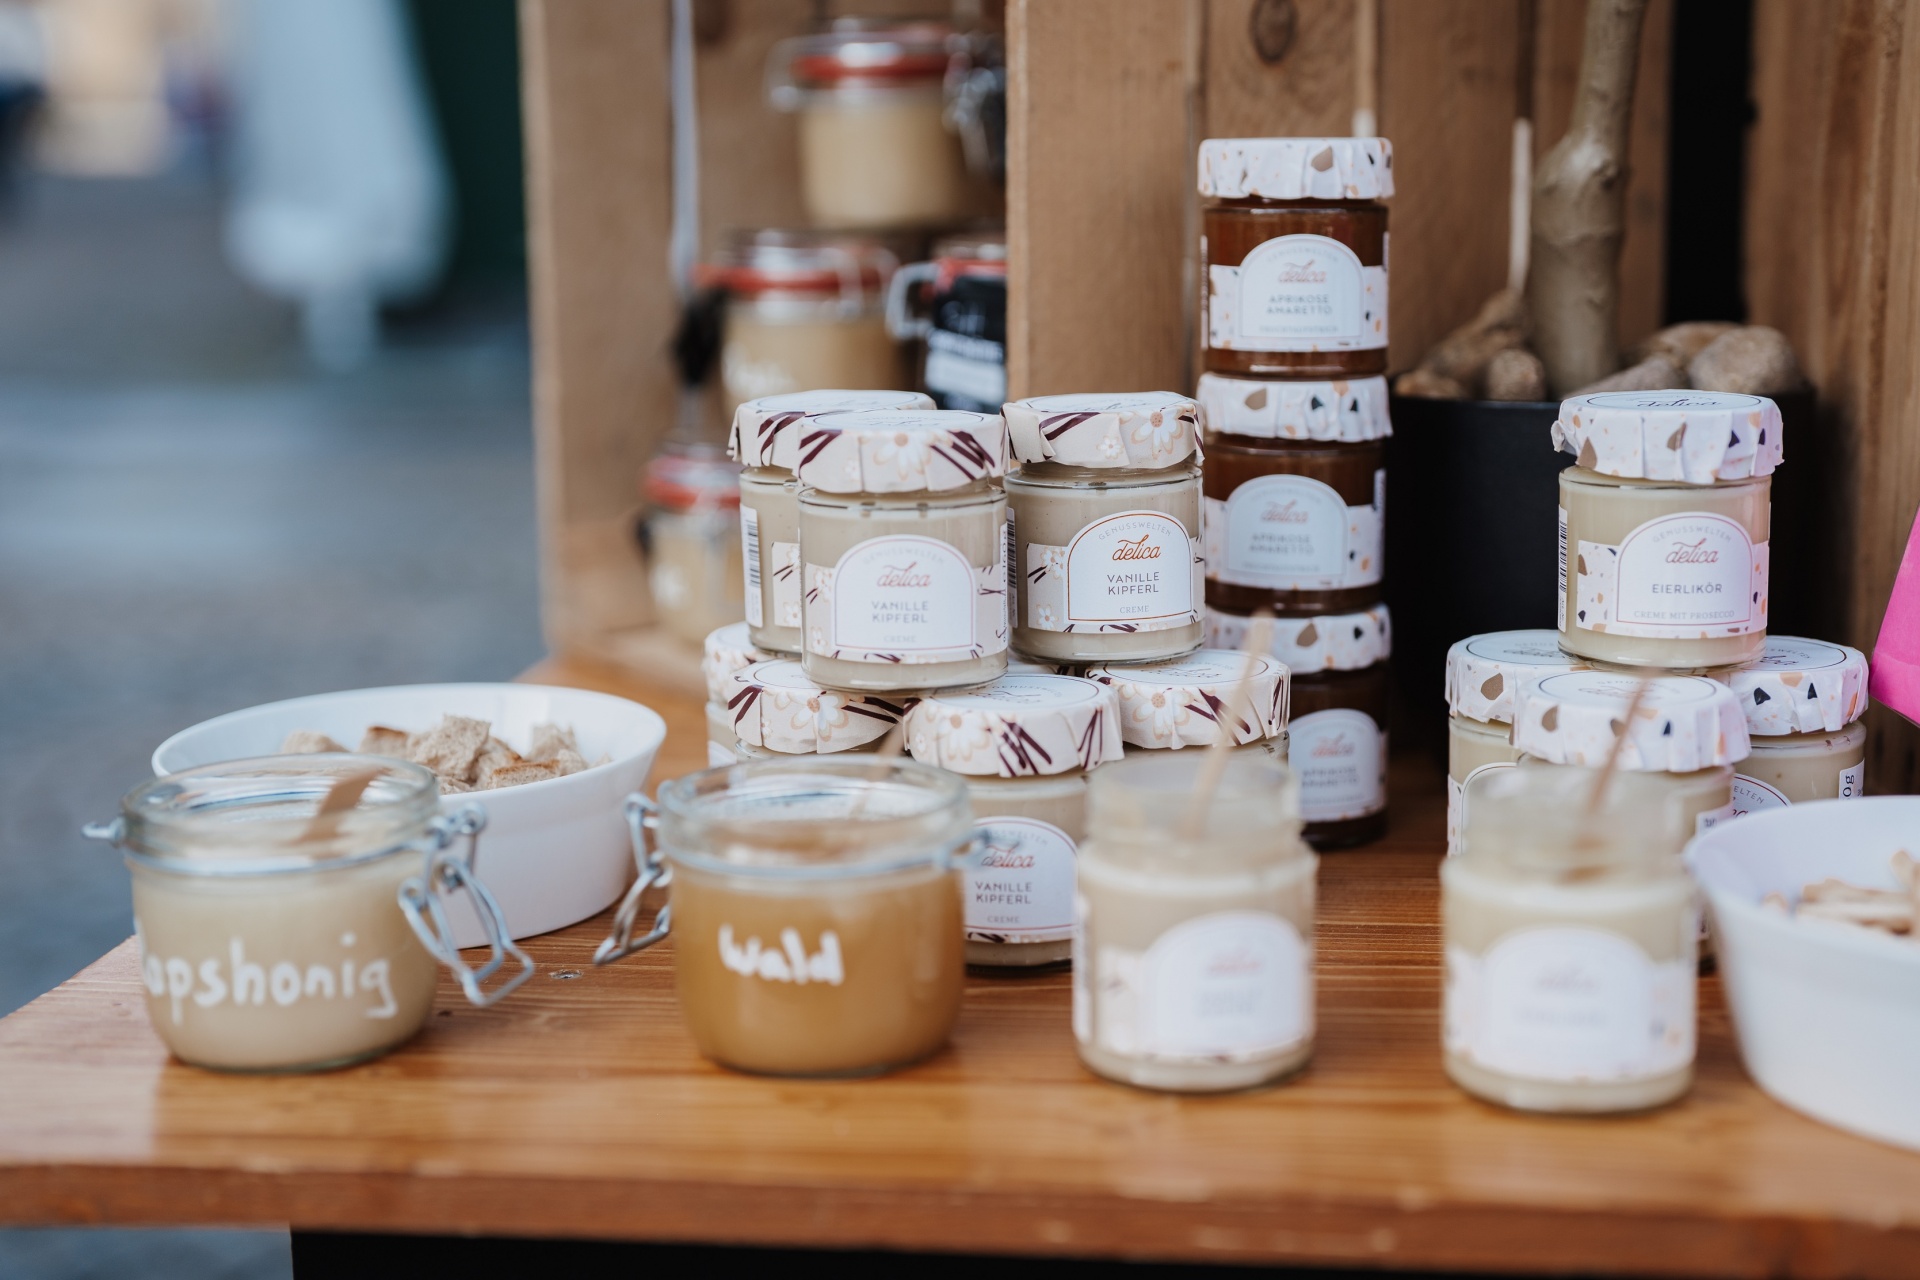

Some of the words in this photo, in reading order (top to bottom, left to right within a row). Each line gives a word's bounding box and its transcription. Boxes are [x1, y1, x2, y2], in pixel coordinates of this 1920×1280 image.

[1098, 521, 1172, 541] GENUSSWELTEN
[1651, 525, 1732, 543] GENUSSWELTEN
[1112, 533, 1162, 561] delica
[1665, 537, 1720, 564] delica
[876, 560, 932, 588] delica
[1106, 571, 1160, 583] VANILLE
[1108, 584, 1159, 595] KIPFERL
[1651, 582, 1723, 594] EIERLIKÖR
[871, 600, 929, 611] VANILLE
[1119, 605, 1150, 614] CREME
[872, 613, 928, 624] KIPFERL
[1633, 610, 1667, 620] CREME
[1669, 610, 1686, 619] MIT
[1690, 610, 1735, 619] PROSECCO
[975, 881, 1033, 893] VANILLE
[976, 893, 1032, 905] KIPFERL
[986, 914, 1020, 924] CREME
[144, 934, 399, 1026] apshonig
